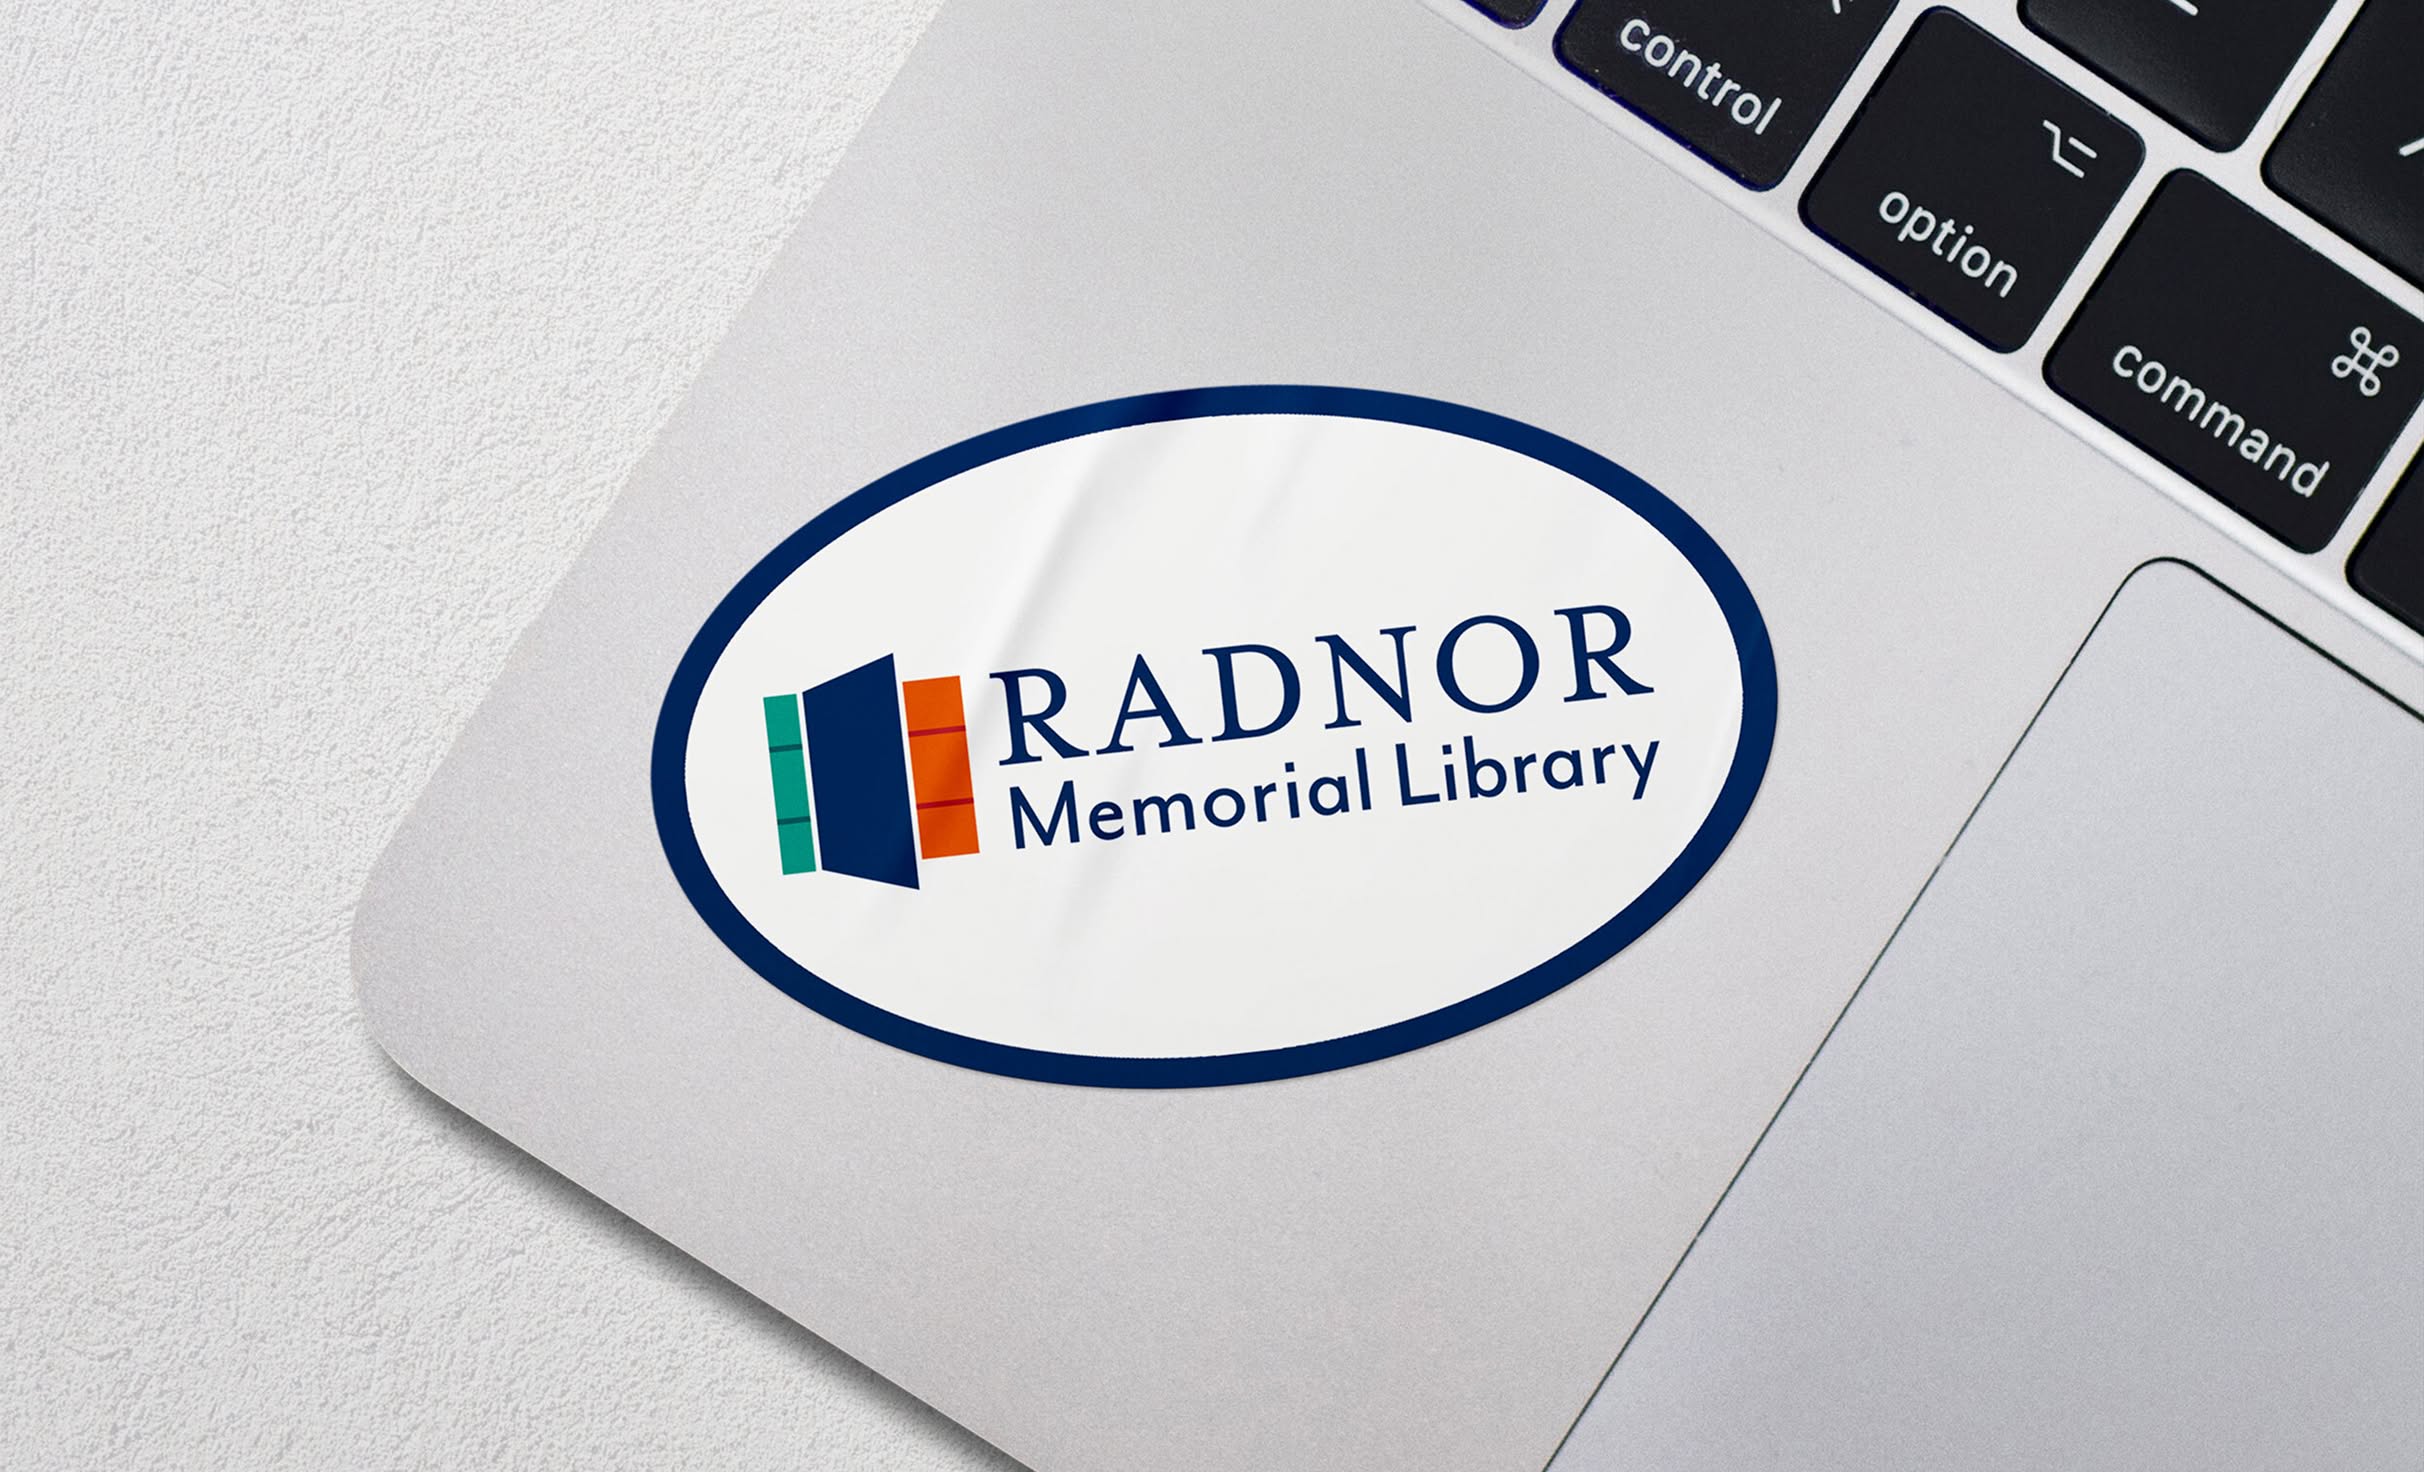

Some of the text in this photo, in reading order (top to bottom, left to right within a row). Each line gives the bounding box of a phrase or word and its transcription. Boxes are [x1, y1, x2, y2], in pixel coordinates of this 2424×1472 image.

[1619, 17, 1783, 136] control
[1878, 190, 2019, 299] option
[2111, 344, 2331, 499] command
[989, 604, 1656, 767] RADNOR
[1009, 735, 1661, 850] Memorial Library
